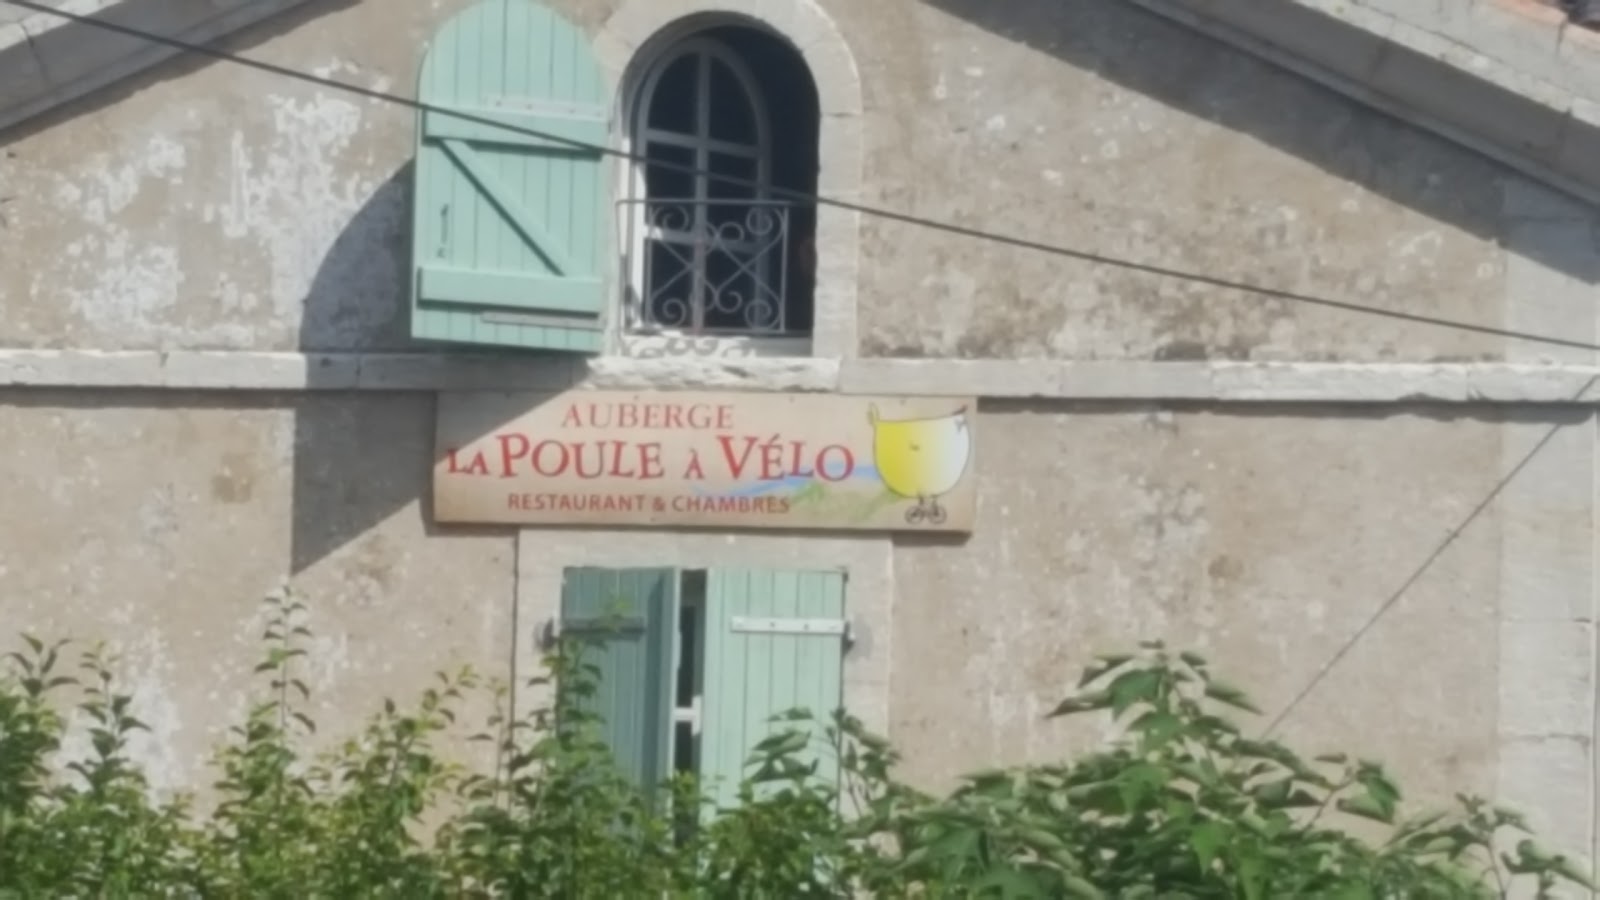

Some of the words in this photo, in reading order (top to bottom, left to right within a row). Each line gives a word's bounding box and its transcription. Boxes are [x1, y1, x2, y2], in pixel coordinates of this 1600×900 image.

[561, 402, 735, 430] AUBERGE
[447, 448, 490, 475] LA
[496, 432, 665, 480] POULE
[682, 447, 705, 480] À
[716, 433, 855, 482] VÉLO
[507, 493, 646, 511] RESTAURANT
[651, 496, 666, 512] &
[671, 496, 791, 515] CHAMBRES
